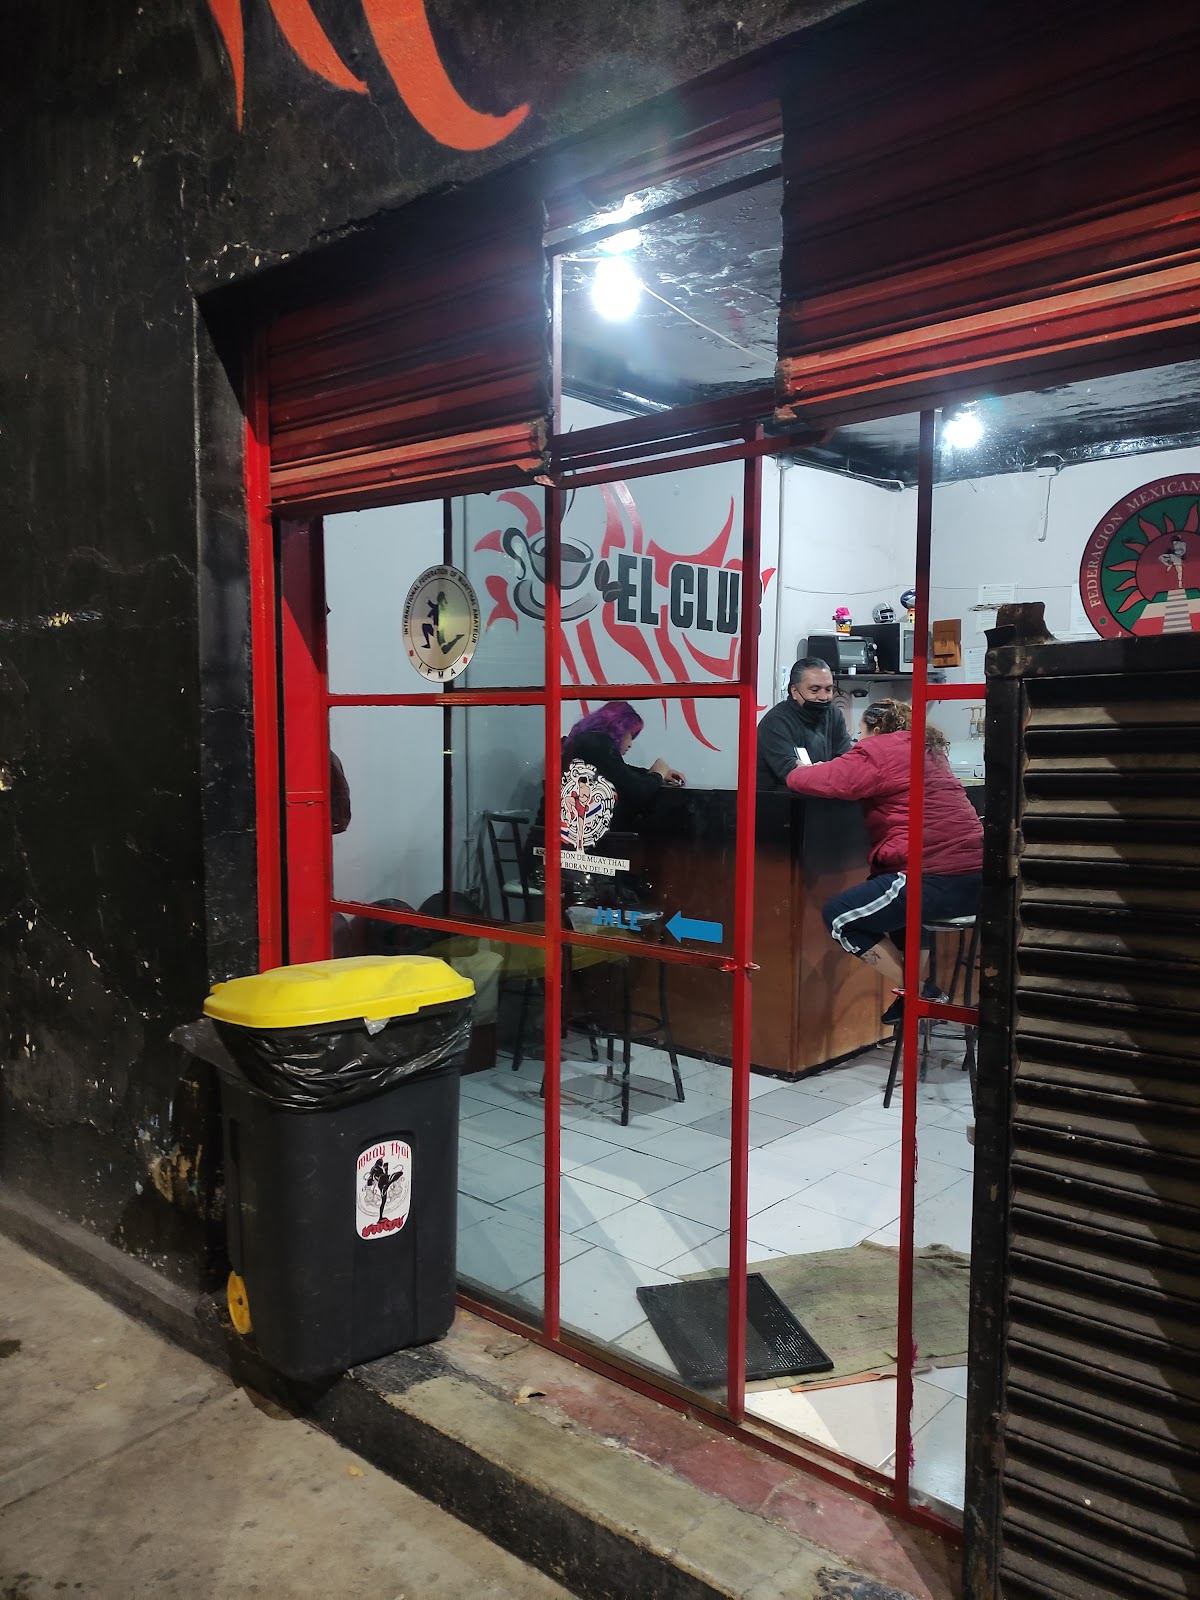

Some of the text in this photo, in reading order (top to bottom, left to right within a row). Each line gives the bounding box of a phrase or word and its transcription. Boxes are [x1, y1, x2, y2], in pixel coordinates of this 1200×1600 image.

[1086, 512, 1124, 608] FEDERACION
[404, 584, 420, 634] INTERNATIONAL
[419, 568, 448, 586] FEDERATION
[618, 554, 762, 635] EL CLU
[564, 862, 588, 871] BORAN
[590, 866, 602, 874] DEL
[577, 854, 586, 862] DE
[586, 856, 606, 865] MUAY
[592, 906, 641, 931] JALE
